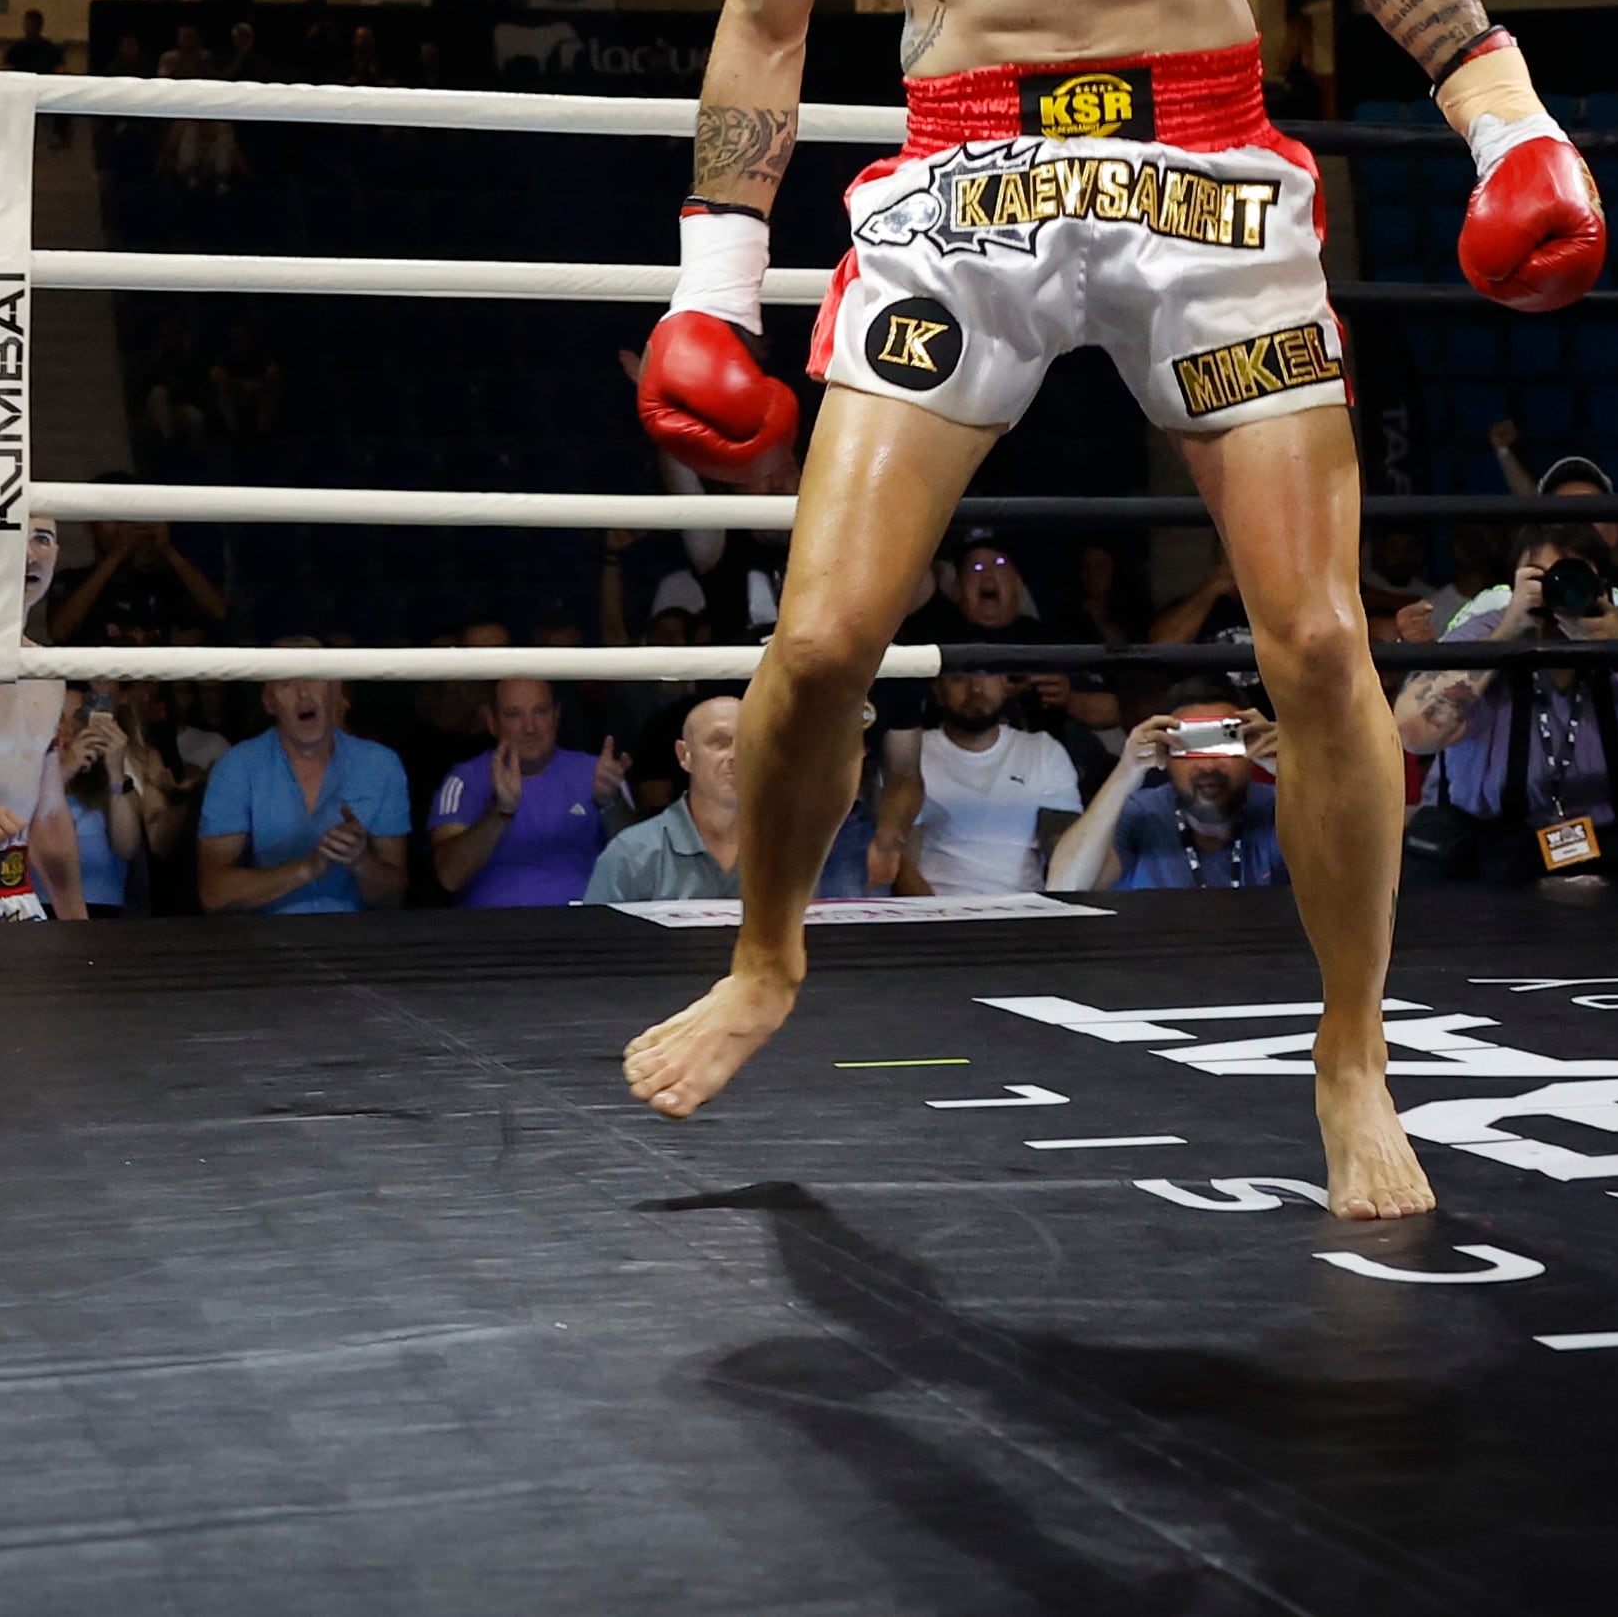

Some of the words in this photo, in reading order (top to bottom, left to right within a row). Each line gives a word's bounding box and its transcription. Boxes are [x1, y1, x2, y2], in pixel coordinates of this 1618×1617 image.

[1040, 90, 1133, 125] KSR
[955, 159, 1276, 247] KAEWSAMRIT
[1179, 327, 1340, 414] MIKEL
